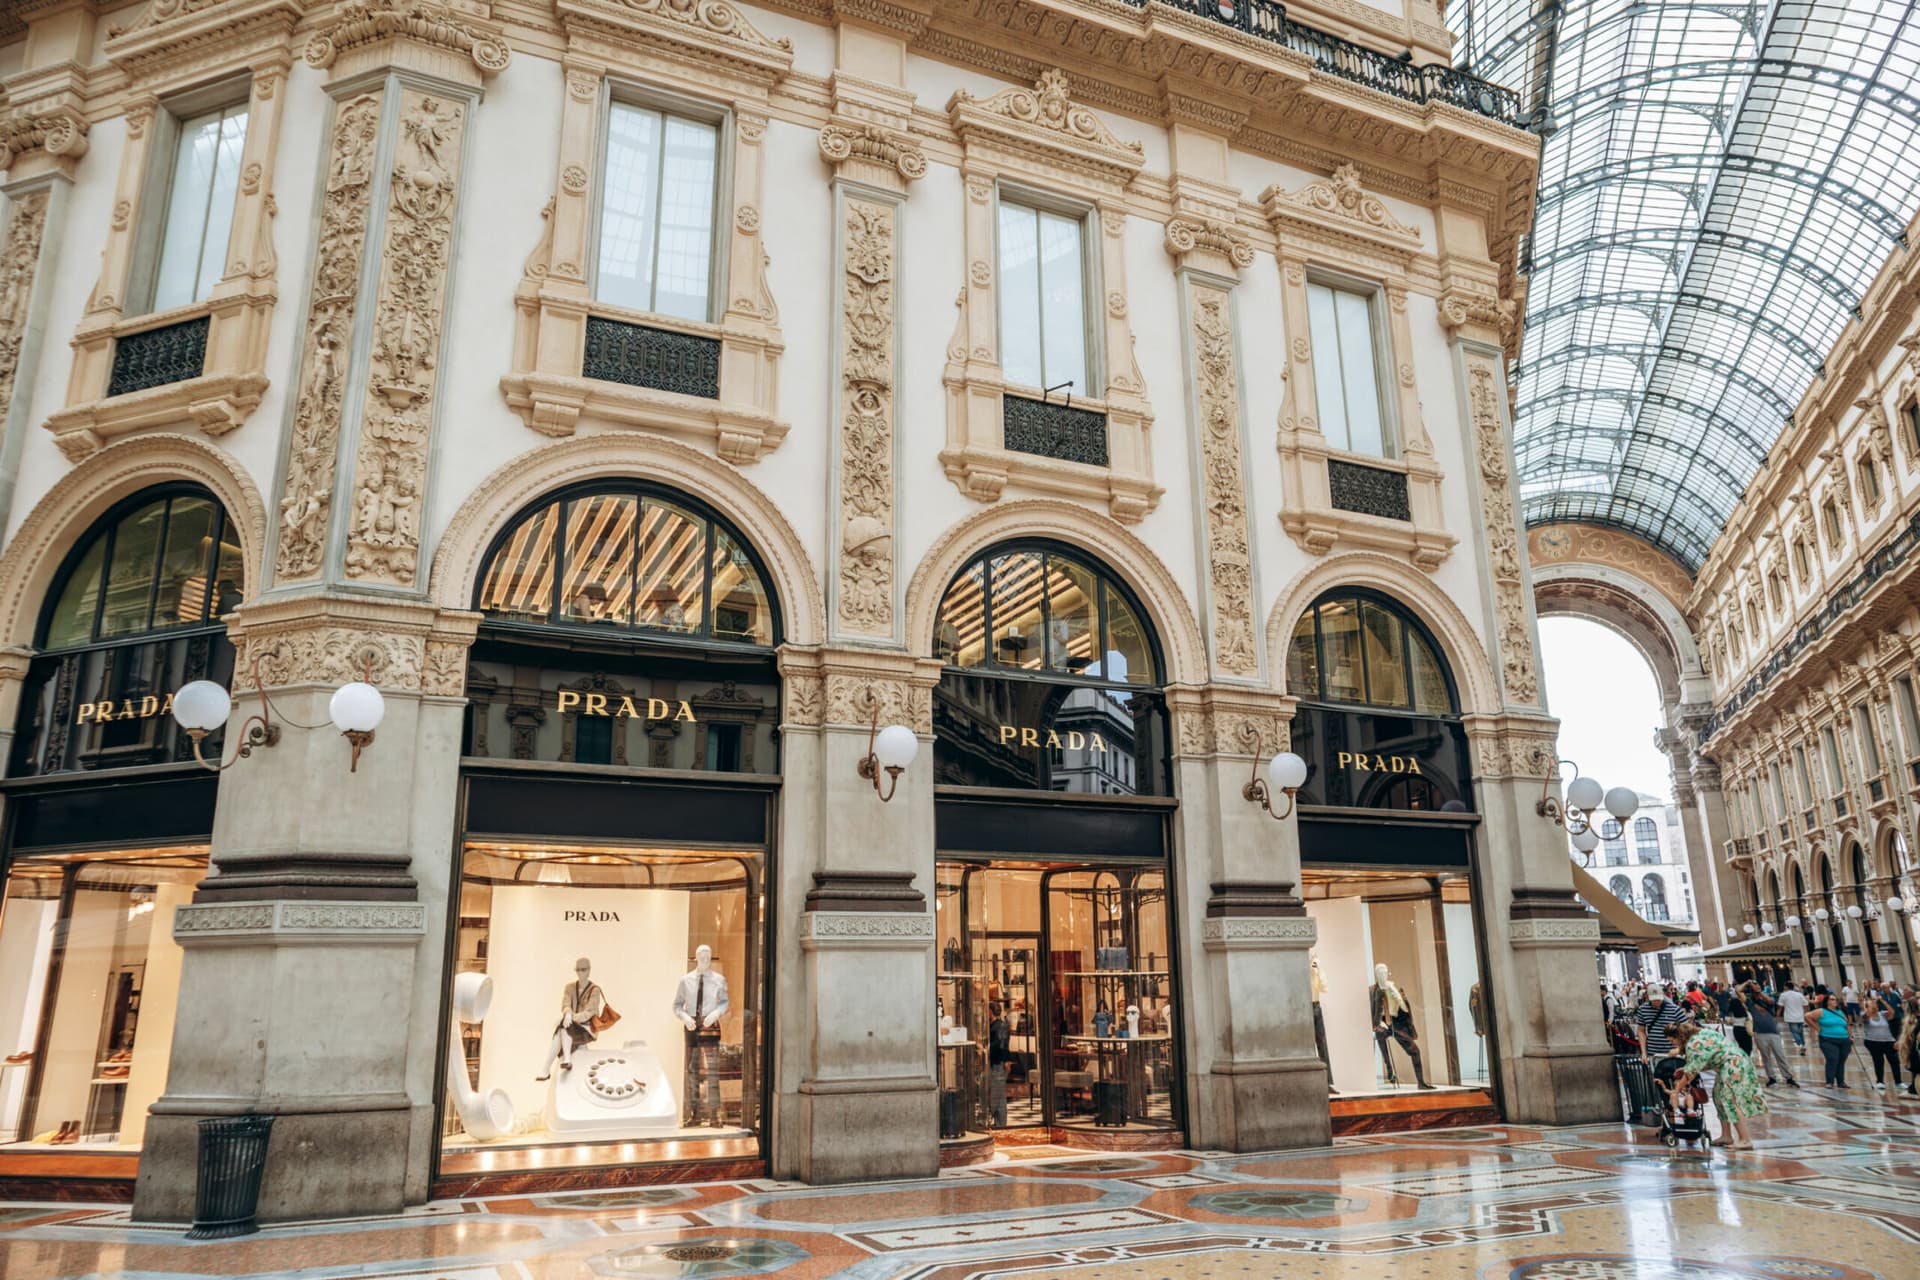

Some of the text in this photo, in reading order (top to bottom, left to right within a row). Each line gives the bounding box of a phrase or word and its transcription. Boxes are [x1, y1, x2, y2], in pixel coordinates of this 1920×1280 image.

[76, 693, 174, 725] PRADA
[556, 691, 698, 722] PRADA
[1000, 725, 1107, 752] PRADA
[1338, 751, 1422, 774] PRADA
[564, 910, 620, 922] PRADA
